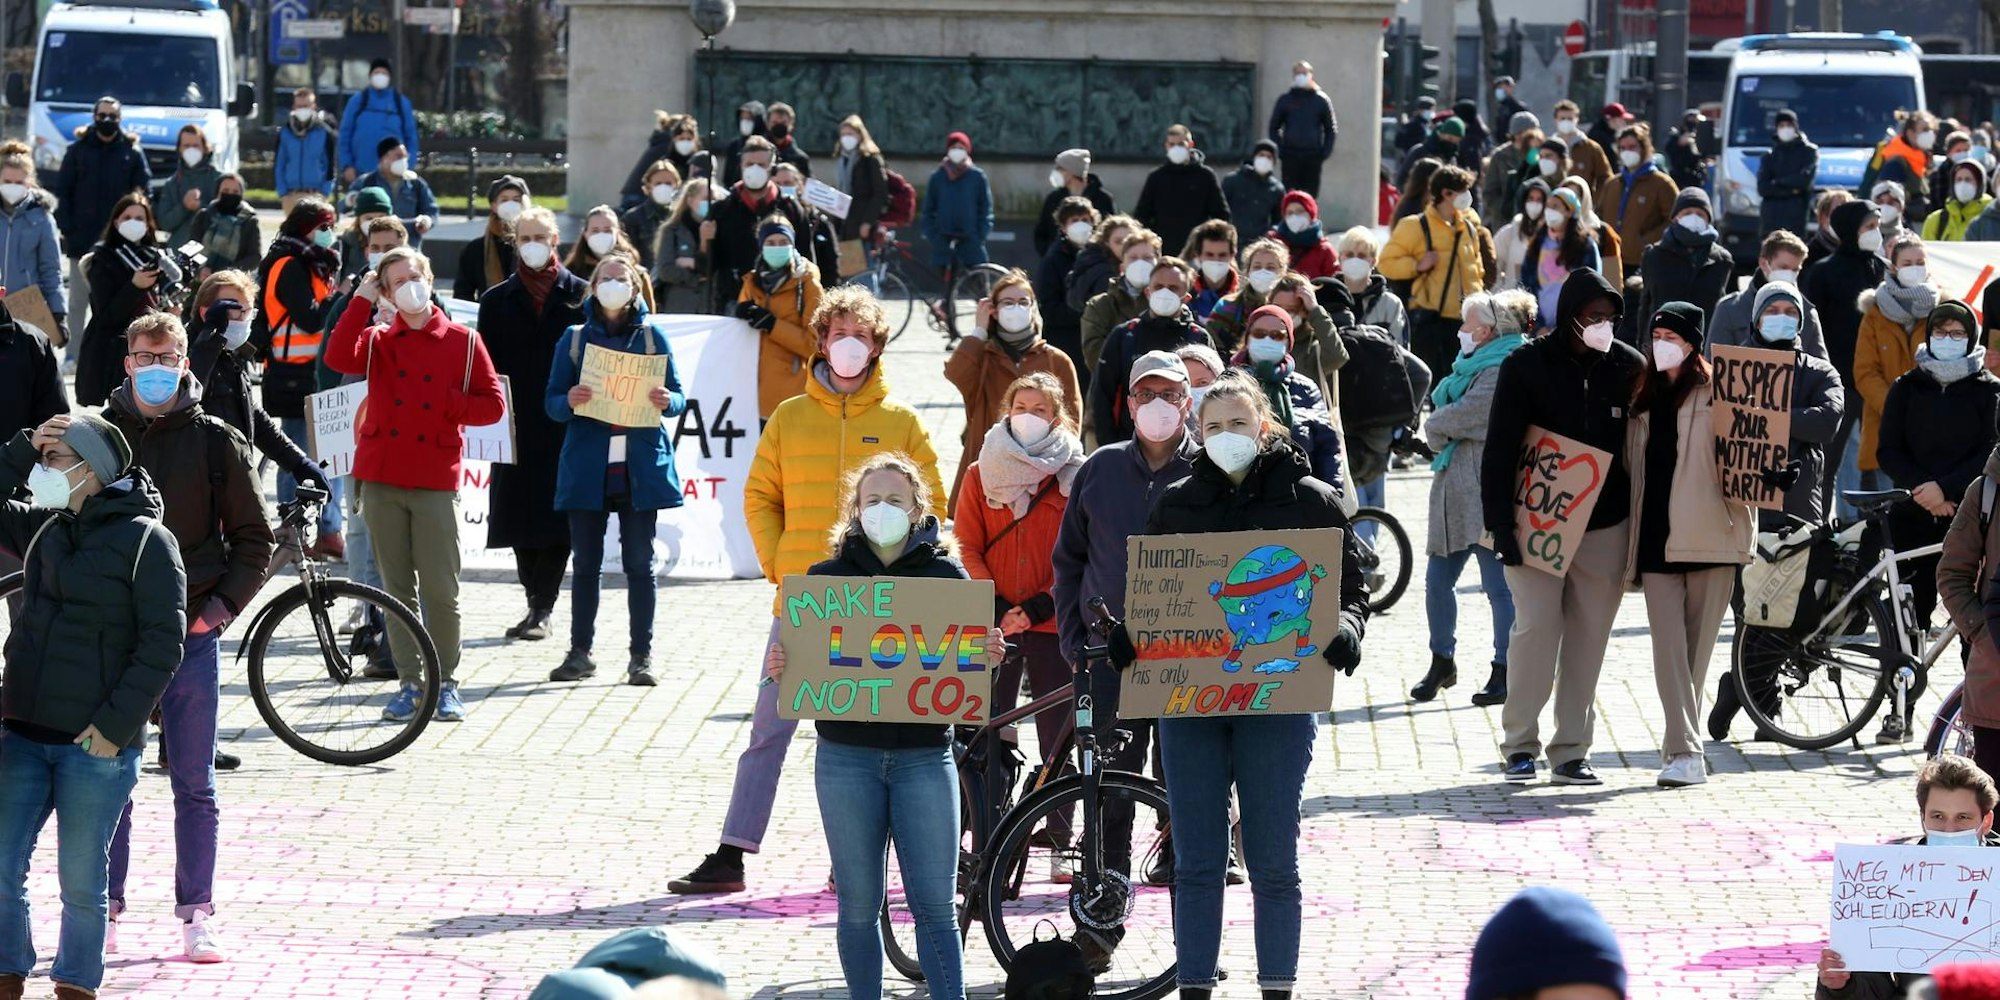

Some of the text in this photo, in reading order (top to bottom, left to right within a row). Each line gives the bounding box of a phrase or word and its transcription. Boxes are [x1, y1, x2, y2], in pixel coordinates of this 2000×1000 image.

[585, 346, 625, 374] SYSTEM
[604, 375, 641, 404] NOT
[1713, 356, 1793, 412] RESPECT
[319, 391, 350, 409] KEIN
[319, 419, 350, 435] BOGEN
[1729, 407, 1769, 440] YOUR
[1715, 435, 1787, 474] MOTHER
[1514, 478, 1574, 523] LOVE
[1137, 541, 1195, 569] human
[1132, 573, 1183, 595] the only
[787, 581, 895, 627] MAKE
[1131, 597, 1197, 626] being that
[829, 623, 988, 672] LOVE
[1136, 628, 1225, 651] DESTROYS
[1131, 662, 1189, 685] his only
[792, 678, 893, 716] NOT
[1163, 681, 1283, 716] HOME
[1839, 860, 1888, 882] WEG
[1957, 865, 1993, 882] DEN
